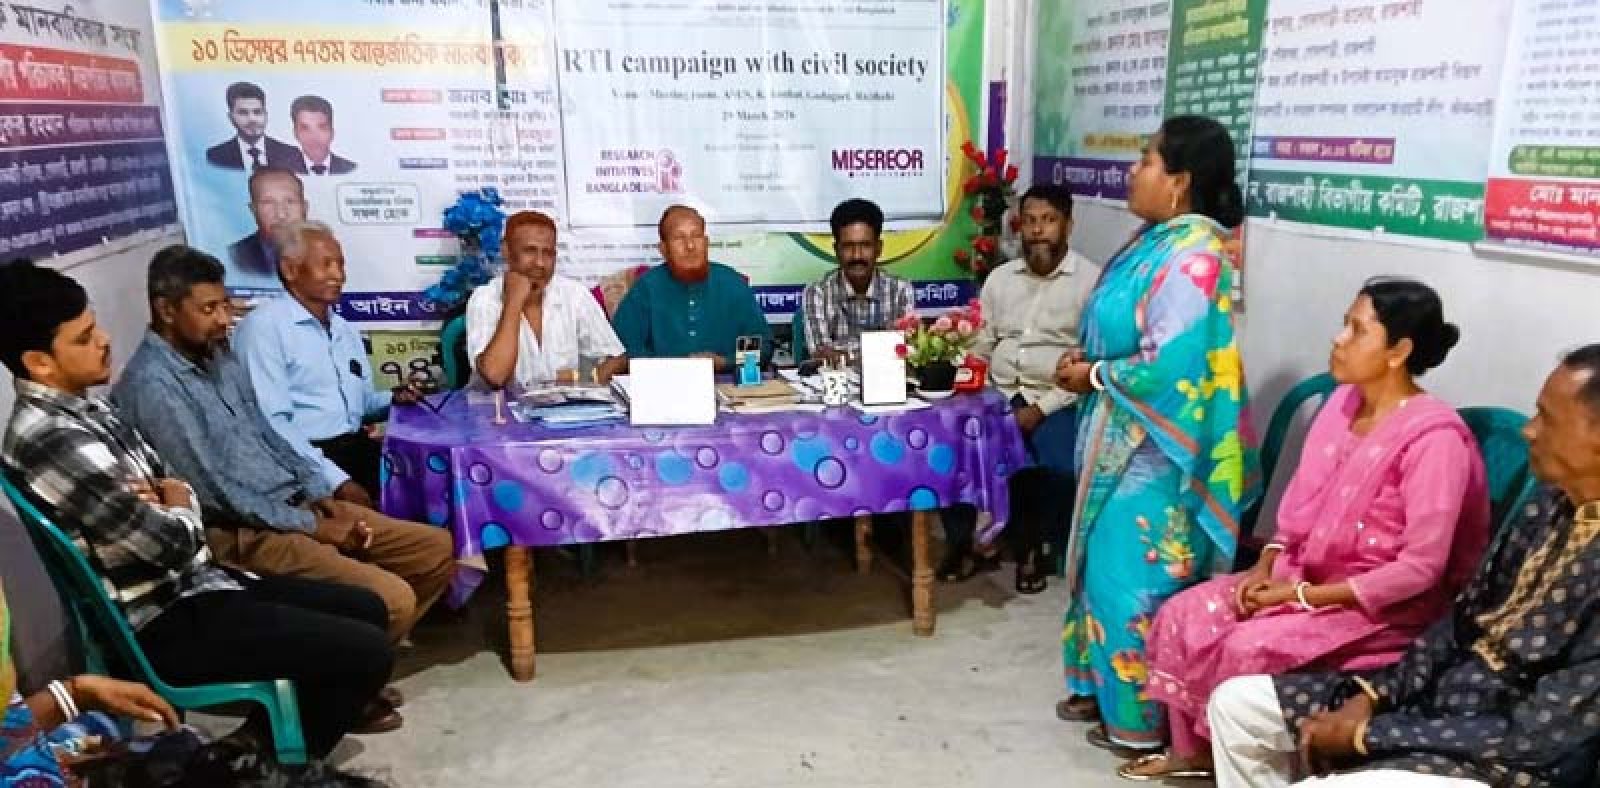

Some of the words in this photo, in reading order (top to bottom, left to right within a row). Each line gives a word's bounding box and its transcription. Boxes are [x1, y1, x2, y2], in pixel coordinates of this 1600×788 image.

[192, 40, 218, 61] ১০
[223, 30, 288, 64] ডিসেম্বর
[563, 48, 611, 72] RTI
[621, 50, 737, 80] campaign
[744, 50, 794, 73] with
[801, 52, 848, 75] civil
[855, 52, 928, 82] society
[831, 149, 924, 171] MISEREOR
[1265, 176, 1315, 211] রাজশাহী
[1433, 194, 1485, 226] রাজশা
[350, 296, 409, 315] আইন
